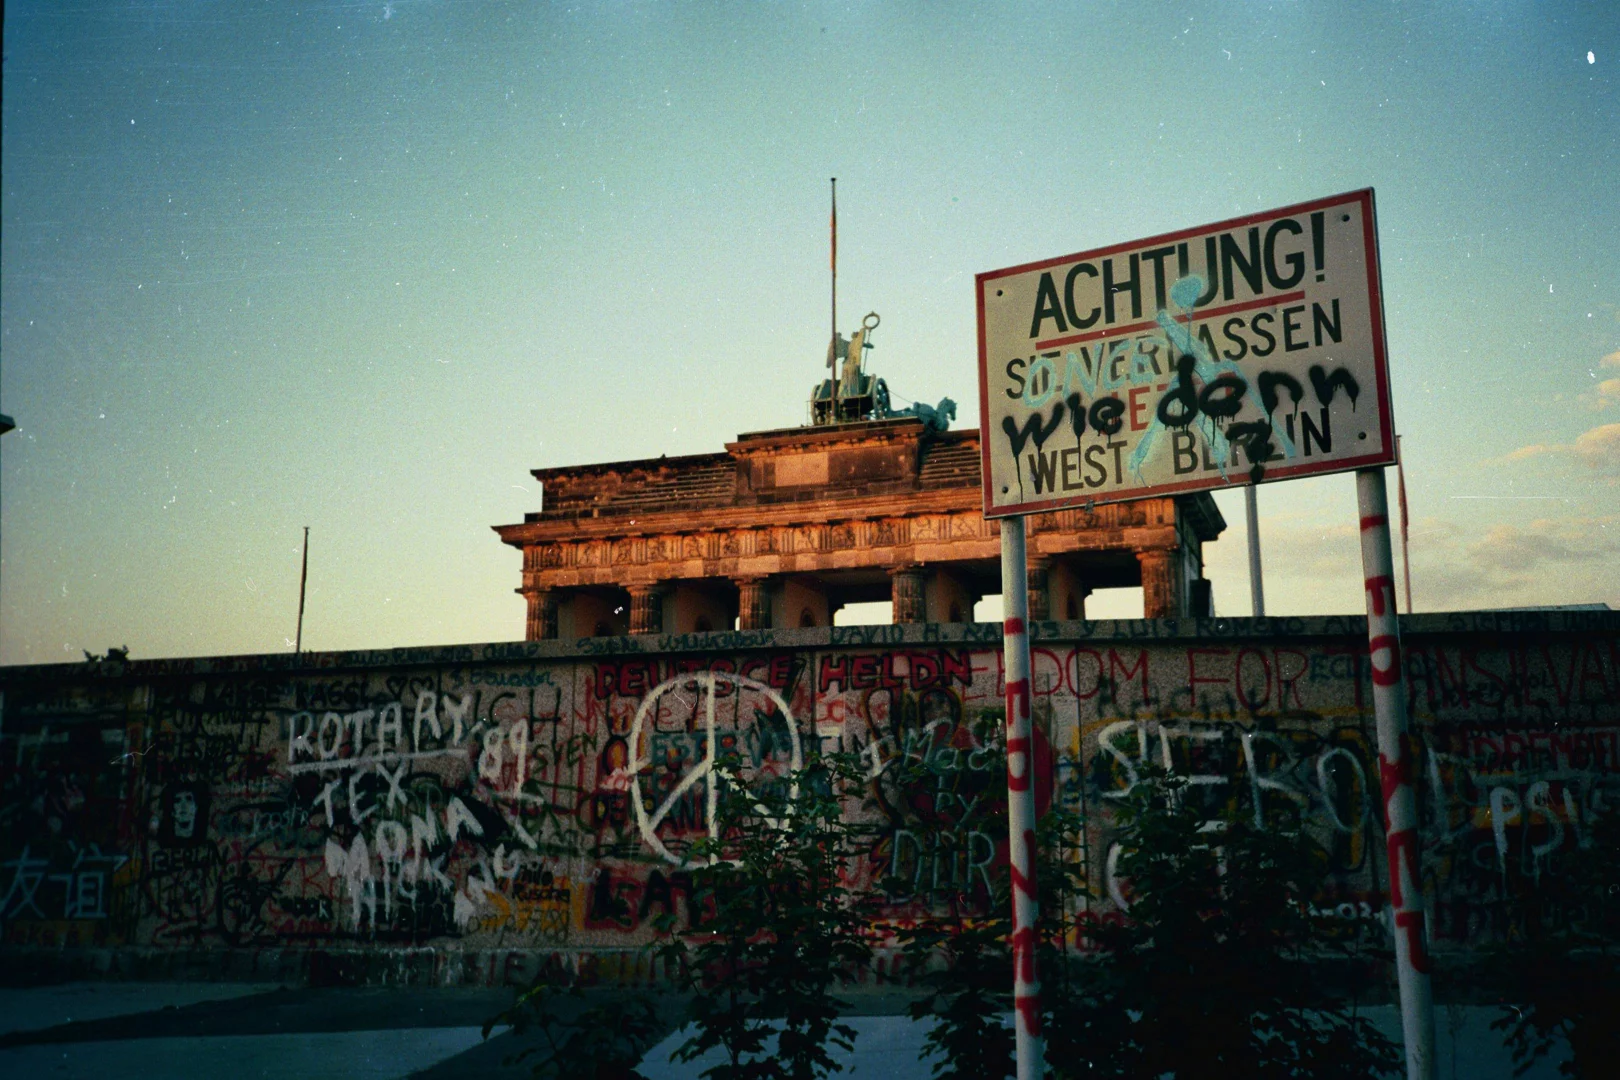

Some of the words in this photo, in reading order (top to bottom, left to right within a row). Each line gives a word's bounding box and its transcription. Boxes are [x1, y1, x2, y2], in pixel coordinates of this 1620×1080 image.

[1029, 211, 1326, 339] ACHTUNG!
[1002, 391, 1126, 458] wie
[1157, 354, 1361, 428] denn
[1028, 440, 1128, 494] WEST
[962, 619, 1062, 642] RAOS
[1187, 646, 1311, 710] FOR
[288, 689, 472, 762] ROTARY
